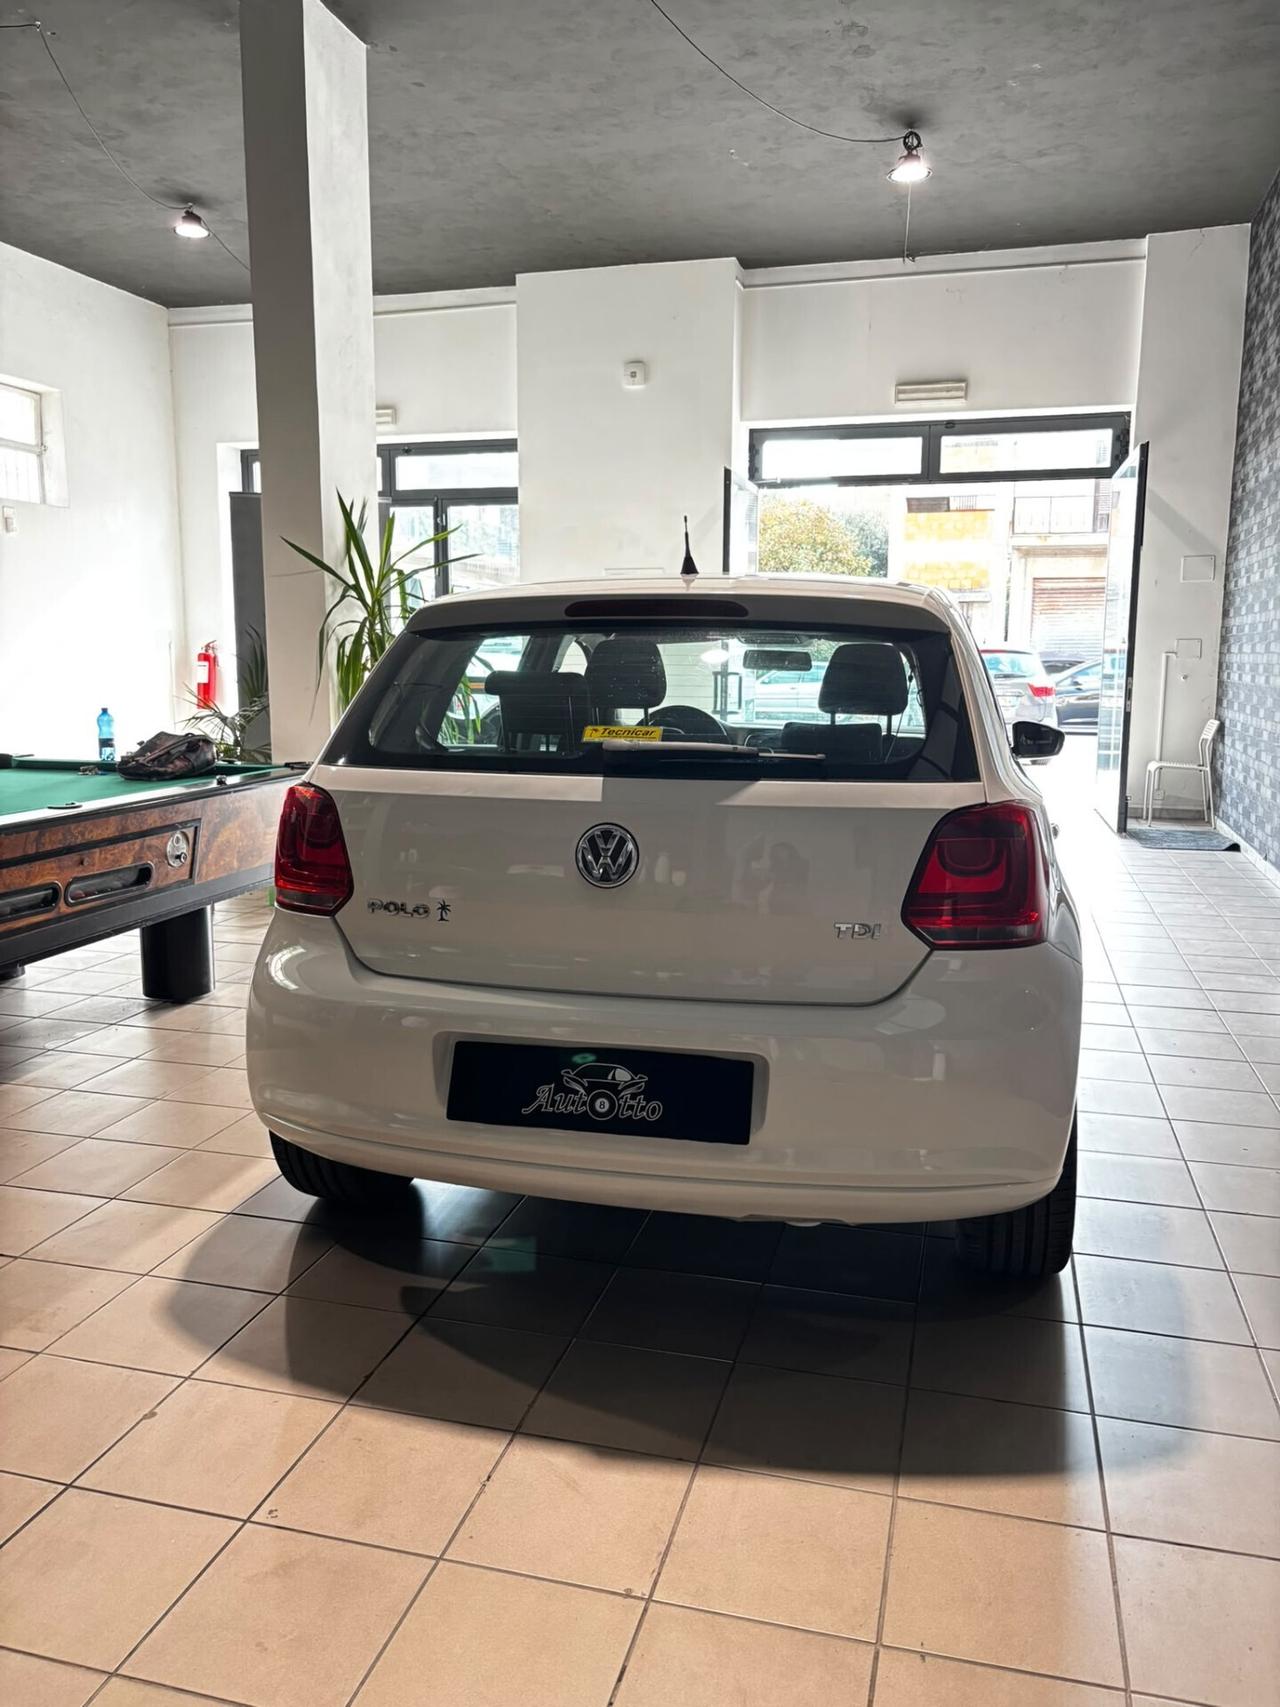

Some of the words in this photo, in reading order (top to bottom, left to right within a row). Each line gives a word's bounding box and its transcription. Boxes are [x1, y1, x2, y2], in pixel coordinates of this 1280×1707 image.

[600, 727, 656, 736] Tecnicar
[367, 898, 431, 919] POLO
[833, 922, 881, 940] TDI
